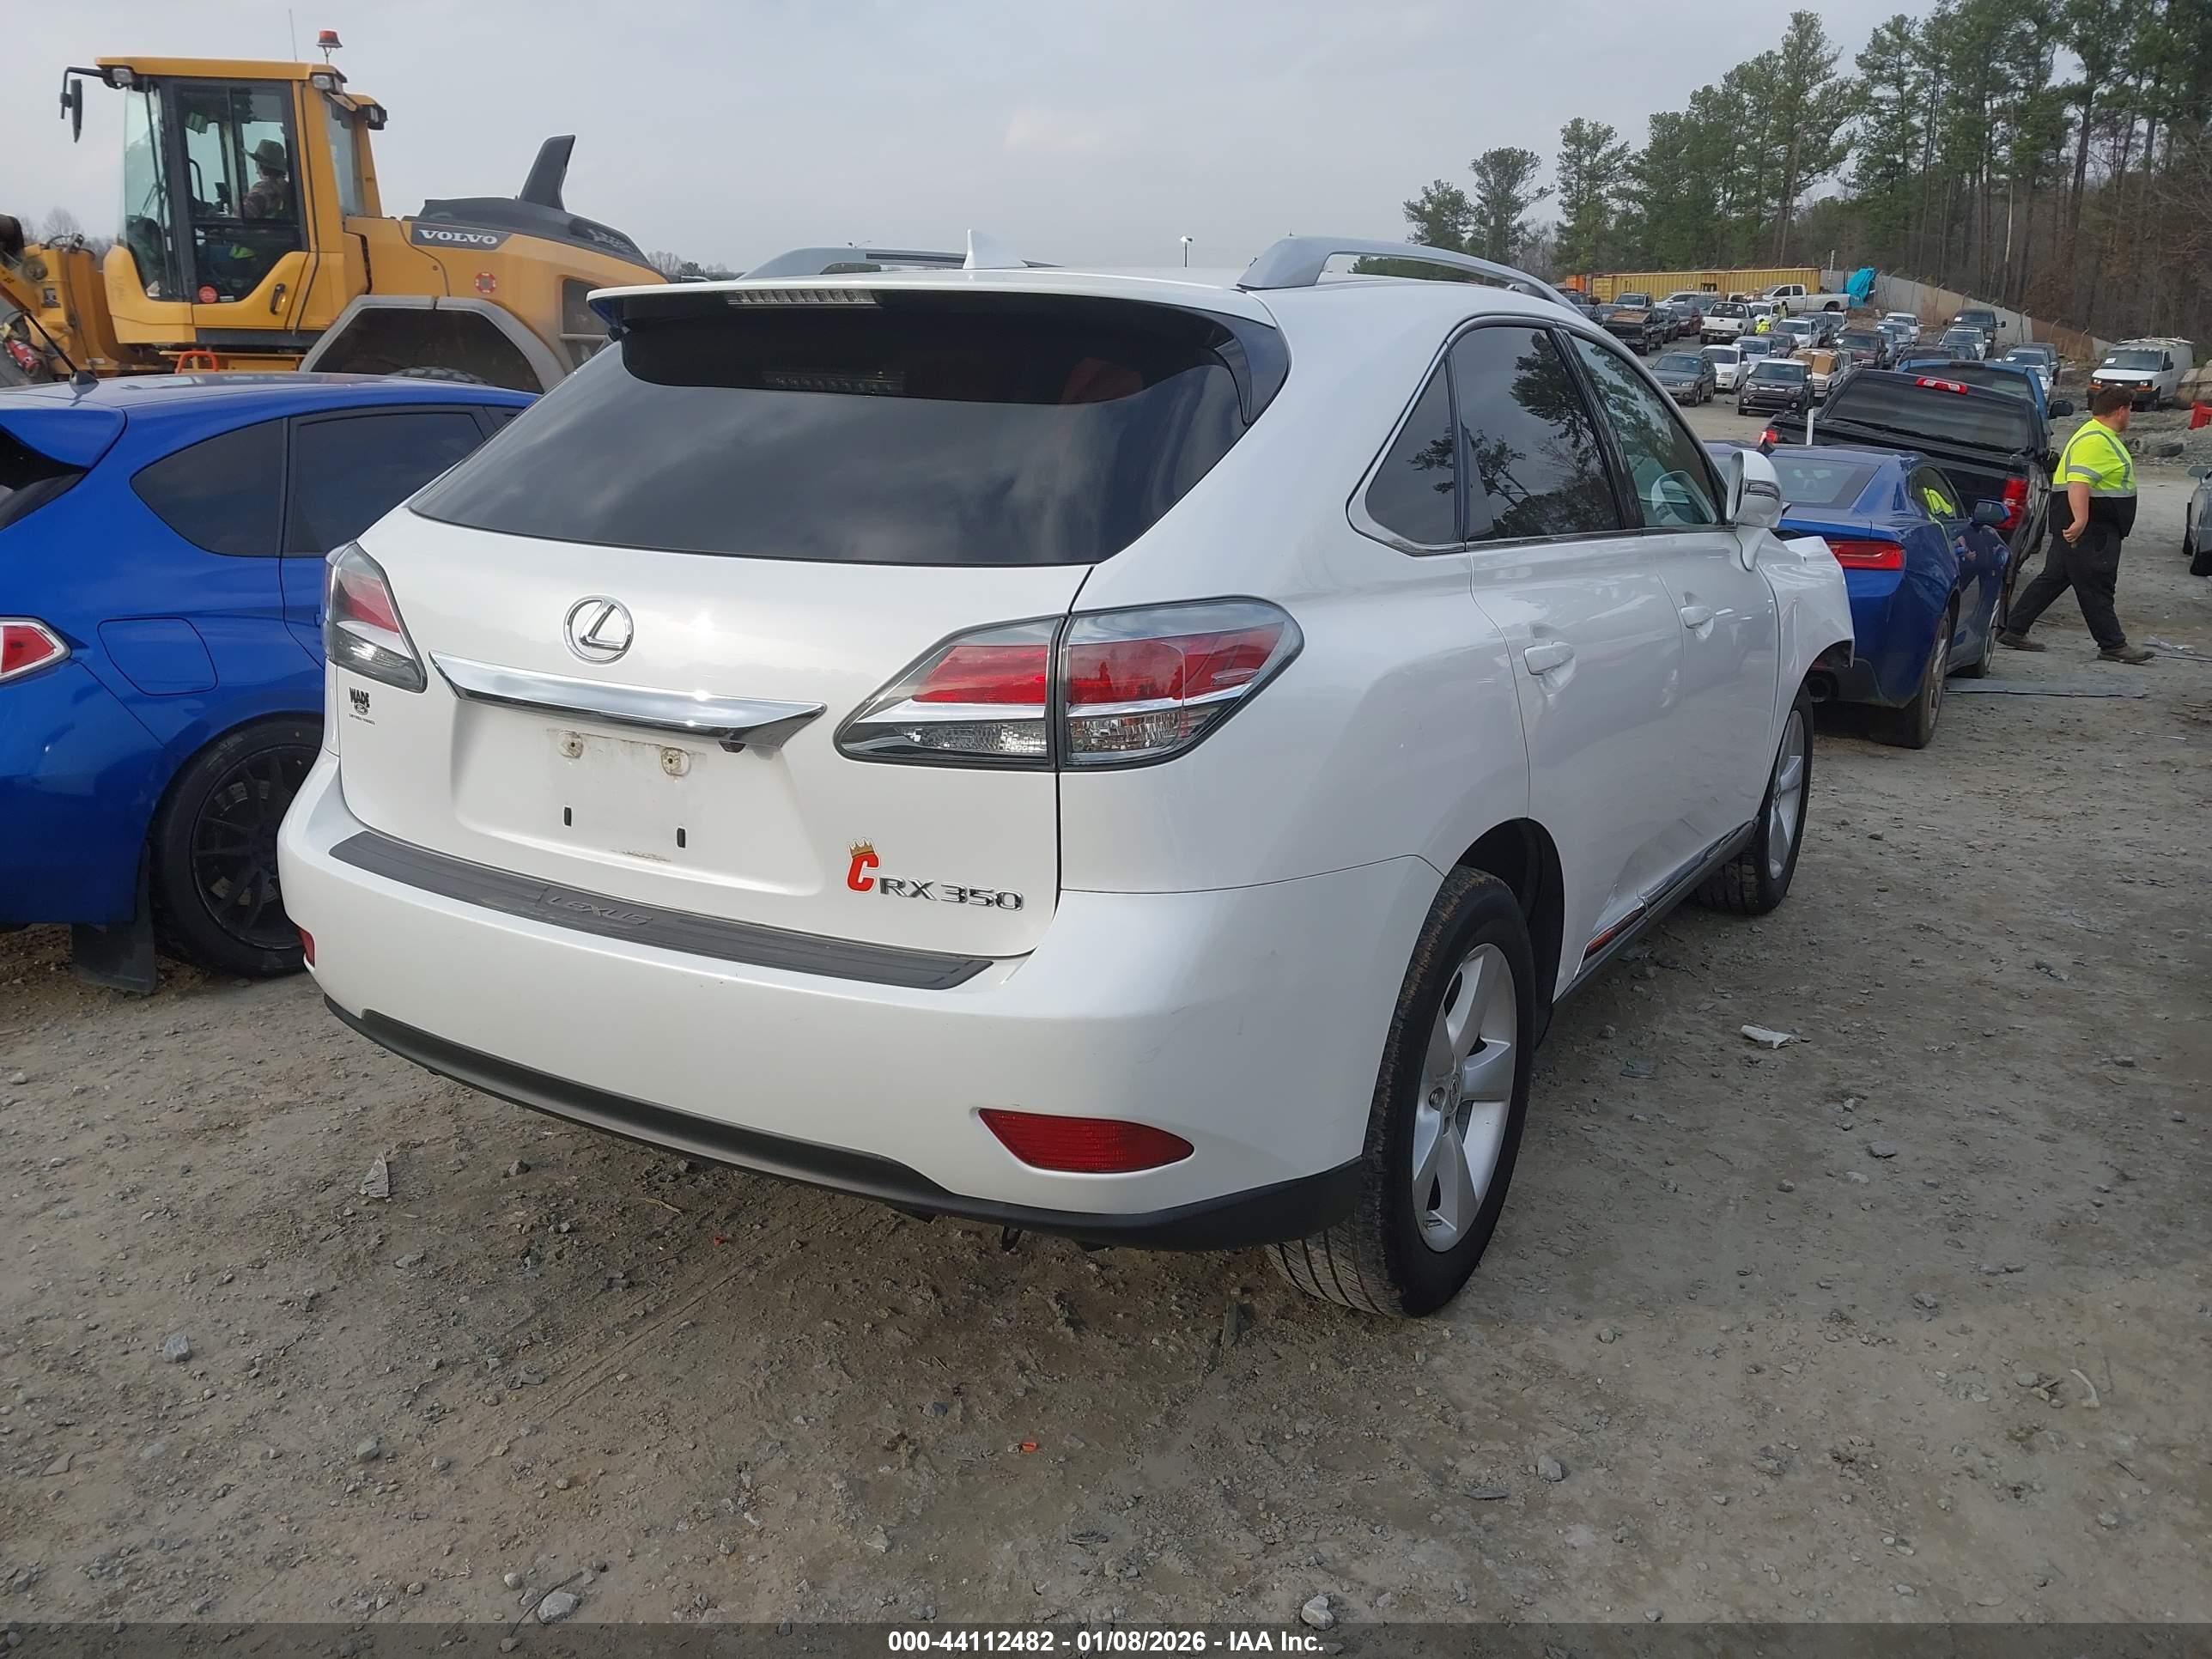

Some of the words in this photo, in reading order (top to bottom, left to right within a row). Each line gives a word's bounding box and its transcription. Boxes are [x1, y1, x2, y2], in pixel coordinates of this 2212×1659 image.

[418, 228, 498, 245] VOLVO
[349, 686, 370, 708] WADE
[878, 874, 938, 902] RX
[940, 881, 1024, 912] 350
[546, 896, 653, 926] LEXUS
